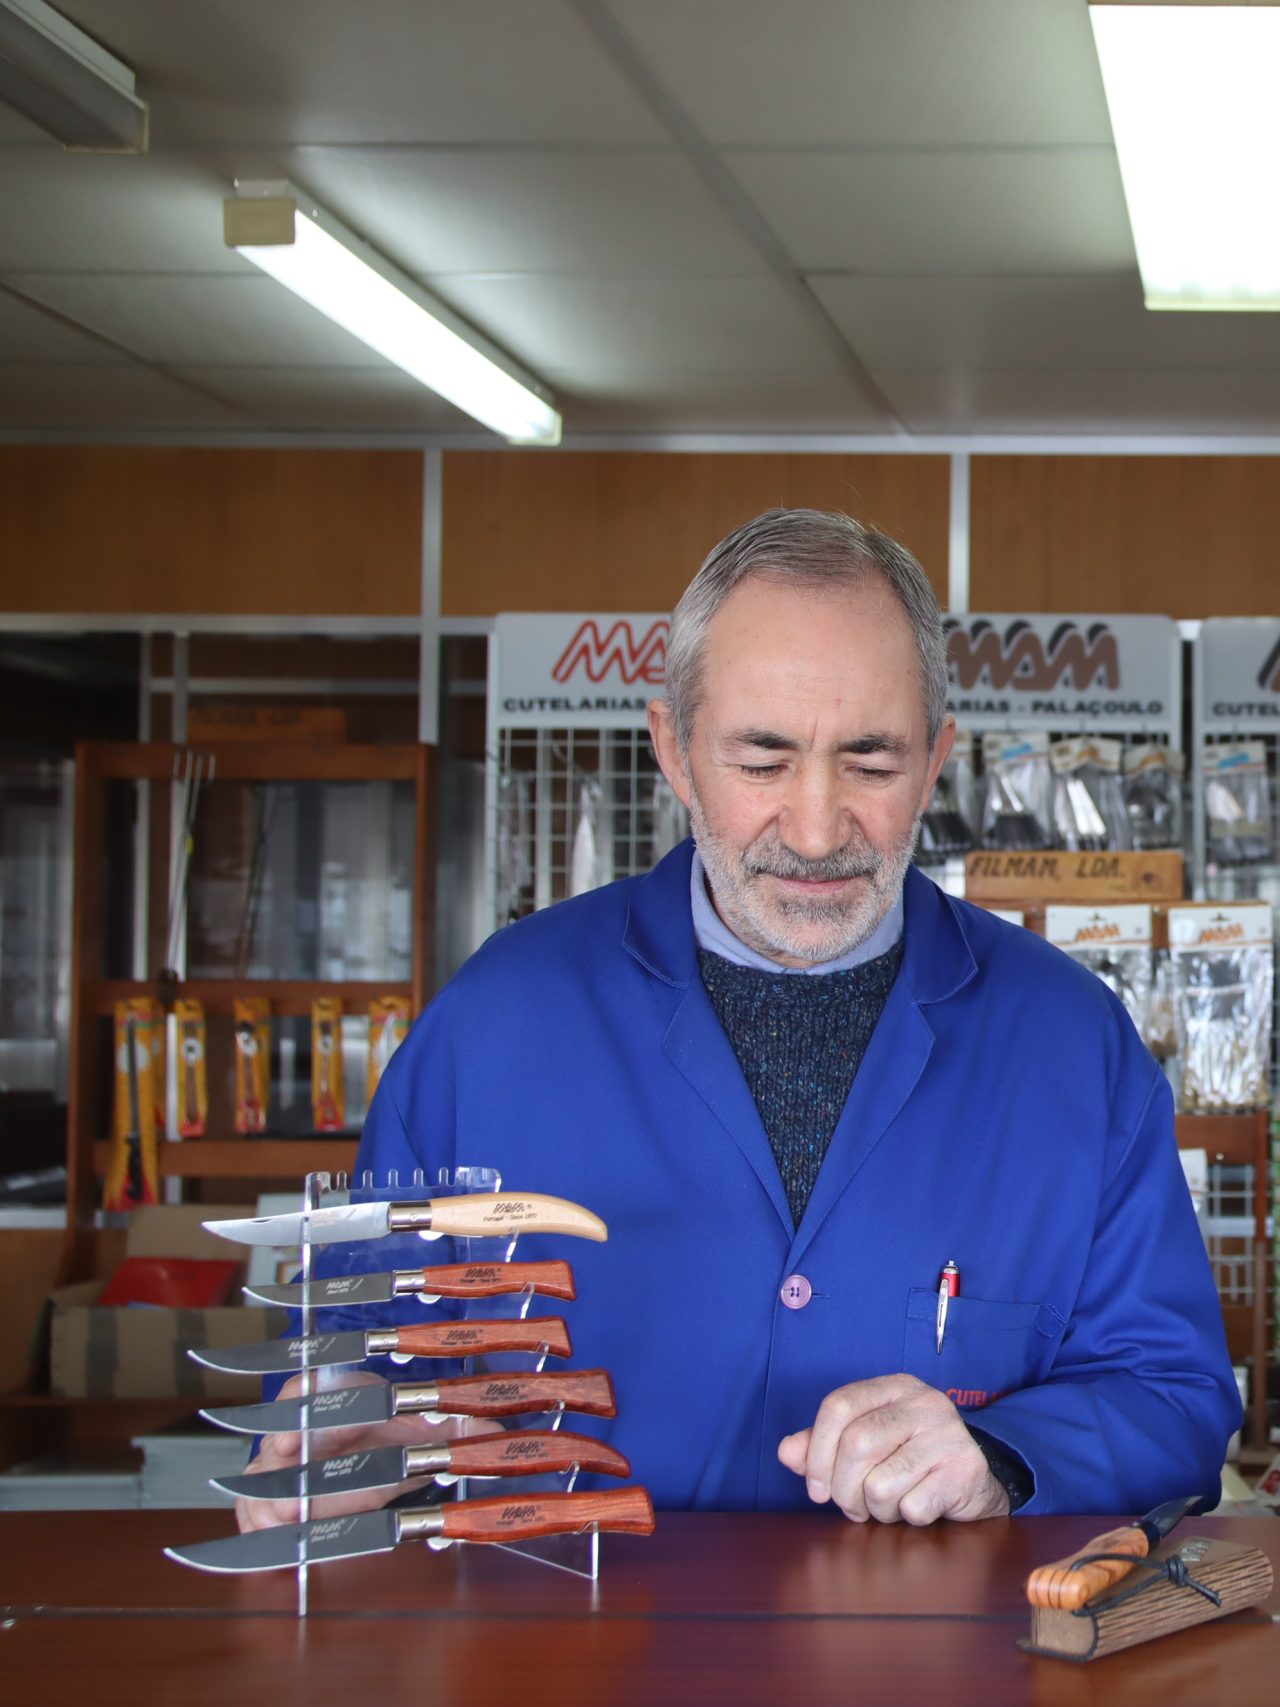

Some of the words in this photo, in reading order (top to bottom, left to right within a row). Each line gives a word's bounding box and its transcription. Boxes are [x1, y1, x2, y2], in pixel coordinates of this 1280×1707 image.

[552, 620, 671, 685] MA
[504, 698, 647, 713] CUTELARIAS
[945, 700, 1010, 713] ARIAS
[1032, 700, 1163, 717] PALAÇOULO
[946, 1388, 997, 1407] CUTEL
